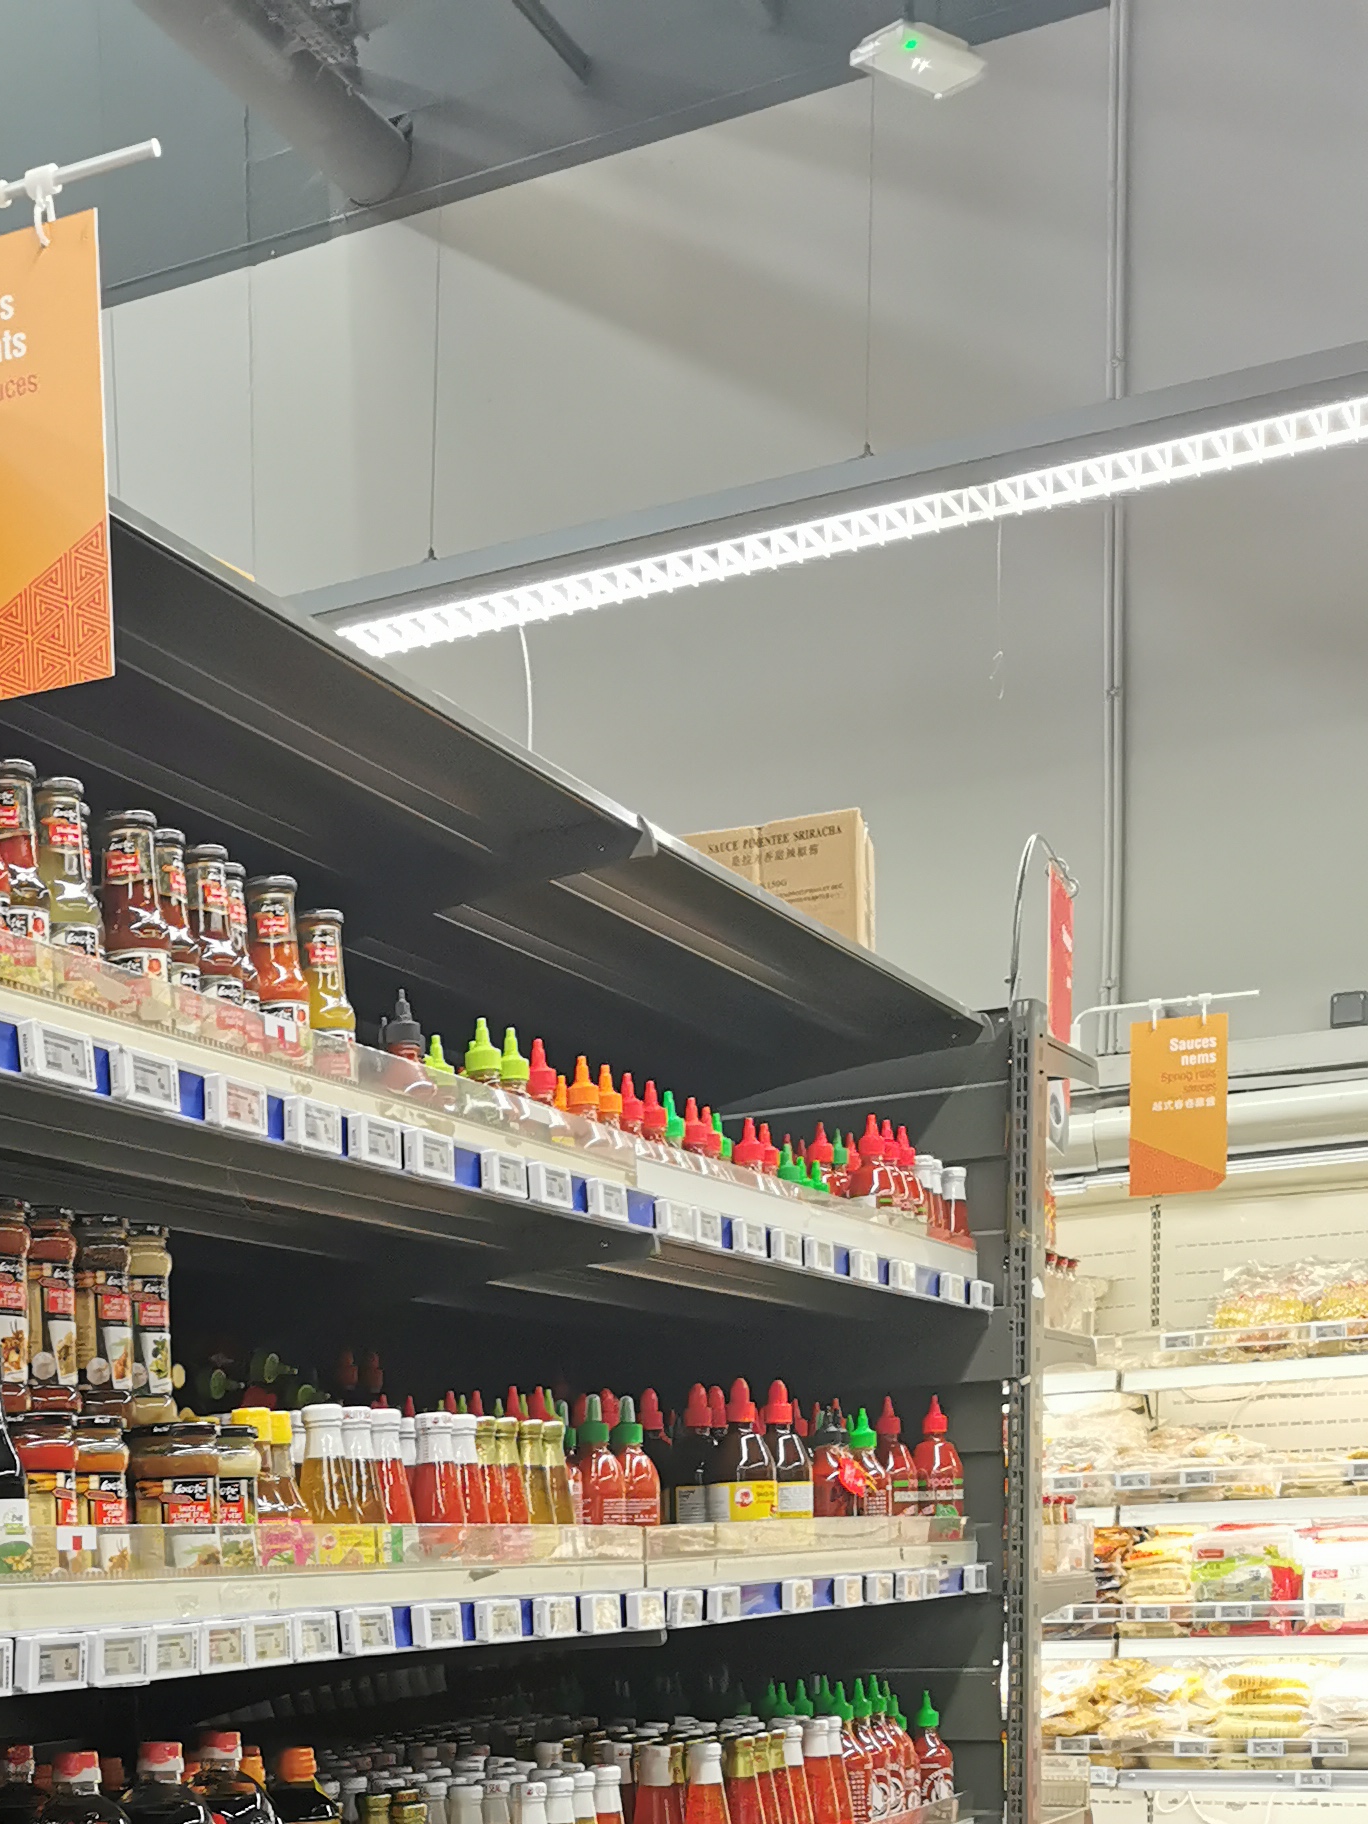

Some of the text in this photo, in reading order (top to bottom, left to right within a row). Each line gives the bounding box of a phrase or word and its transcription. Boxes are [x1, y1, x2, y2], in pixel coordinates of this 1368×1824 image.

[707, 839, 739, 854] SAUCE
[793, 825, 844, 843] SRIRACHA
[1170, 1036, 1217, 1052] Sauces
[1180, 1052, 1217, 1066] nems
